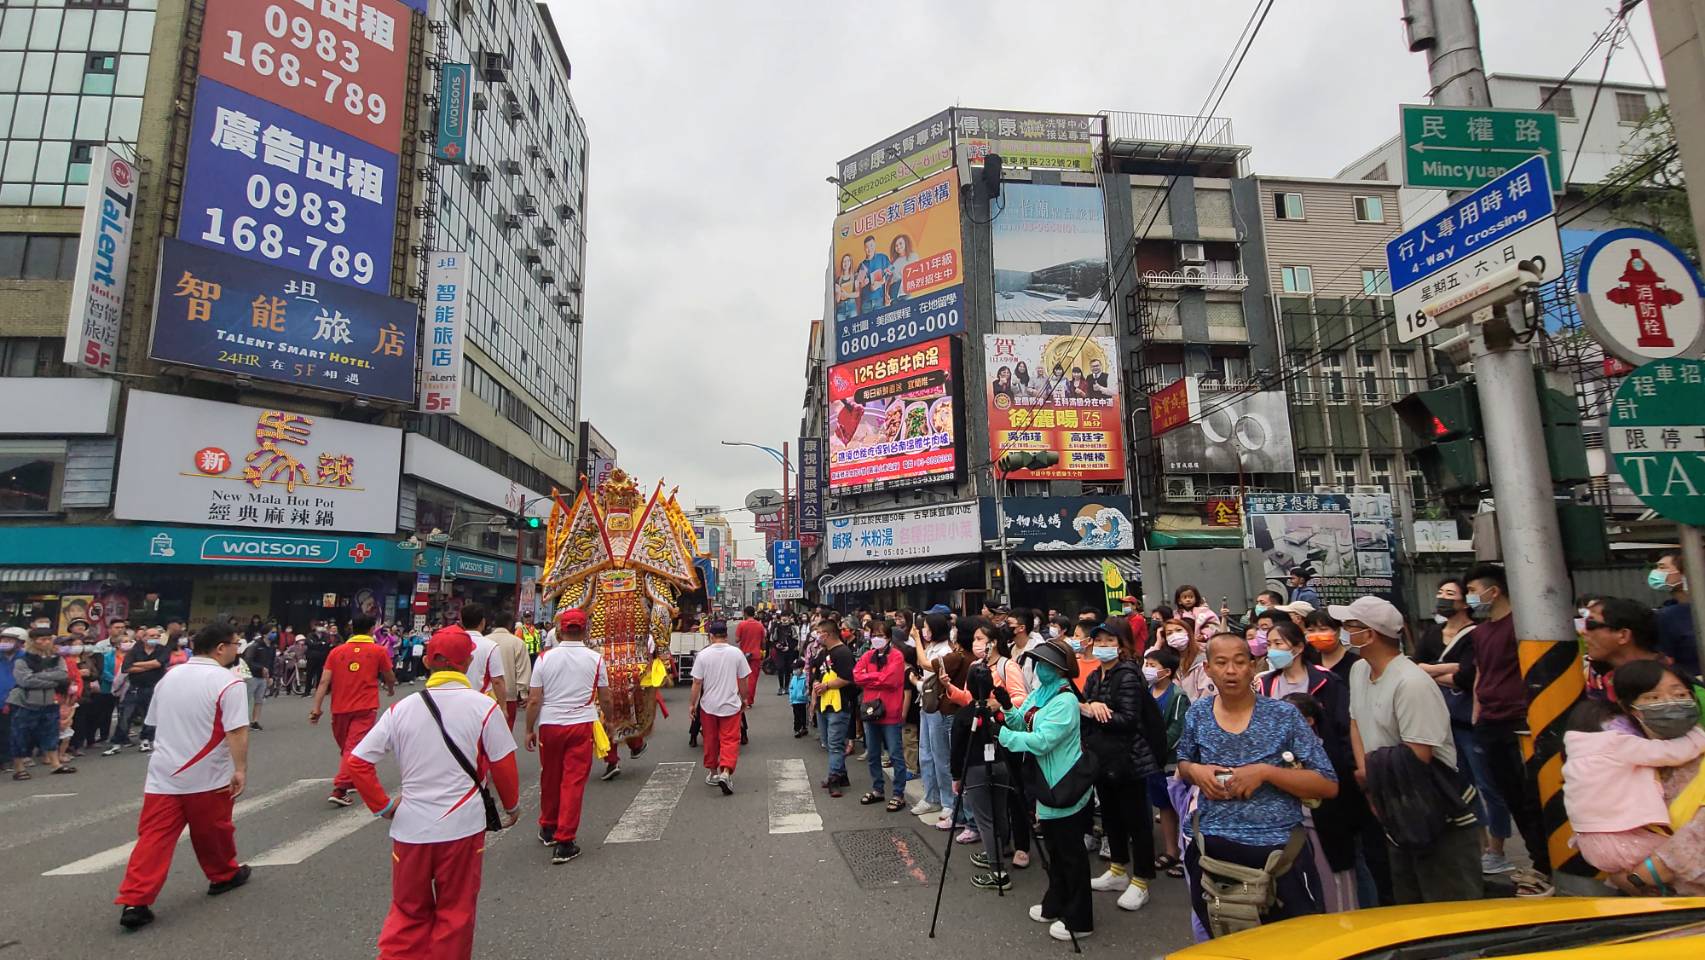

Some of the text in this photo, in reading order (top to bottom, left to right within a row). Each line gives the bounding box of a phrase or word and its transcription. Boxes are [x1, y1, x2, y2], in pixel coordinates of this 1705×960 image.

[265, 5, 360, 73] 0983
[292, 0, 395, 52] 出租
[223, 30, 387, 125] 168-789
[448, 75, 462, 131] watsons
[1421, 115, 1542, 143] 民權路
[210, 106, 384, 205] 廣告出租
[246, 174, 346, 234] 0983
[1398, 172, 1533, 261] 行人專用時相
[202, 207, 374, 285] 168-789
[1411, 209, 1528, 273] 4-Way Crossing
[173, 270, 406, 357] 智能旅店
[431, 284, 456, 367] 智能旅店
[841, 309, 959, 356] 0800-820-000
[1635, 284, 1662, 336] 消防栓
[84, 339, 112, 369] 5F
[217, 350, 262, 368] 24HR
[269, 356, 285, 371] 在
[294, 363, 315, 377] 5F
[994, 337, 1016, 358] 賀
[425, 392, 451, 411] 5F
[1083, 411, 1100, 421] 75
[1615, 364, 1705, 420] 計程車招
[201, 450, 226, 471] 新
[1624, 456, 1705, 497] TA
[208, 503, 335, 527] 經典麻辣鍋
[212, 490, 335, 509] New Mala Hot Pot
[223, 540, 321, 557] watsons
[860, 527, 893, 547] 米粉湯
